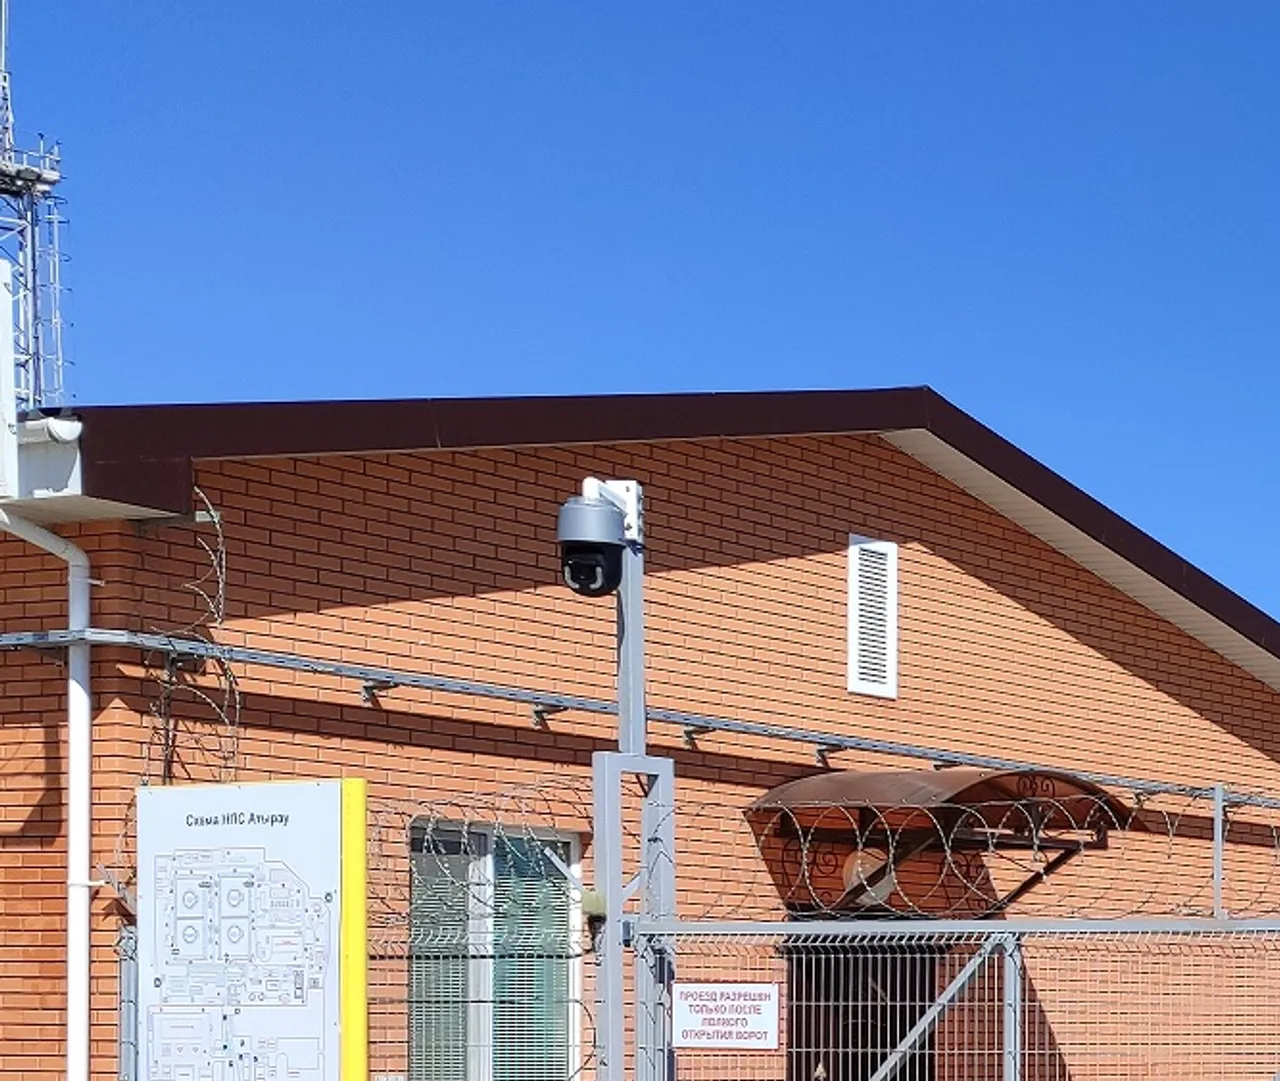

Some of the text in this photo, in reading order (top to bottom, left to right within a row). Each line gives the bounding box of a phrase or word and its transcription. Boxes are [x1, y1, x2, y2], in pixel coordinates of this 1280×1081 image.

[679, 991, 771, 1002] ПРОЕЗД РАЗРЕШЕН
[688, 1004, 762, 1015] ТОЛЬКО ПОСЛЕ
[681, 1029, 768, 1040] ОТКРЫТИЯ ВОРОТ
